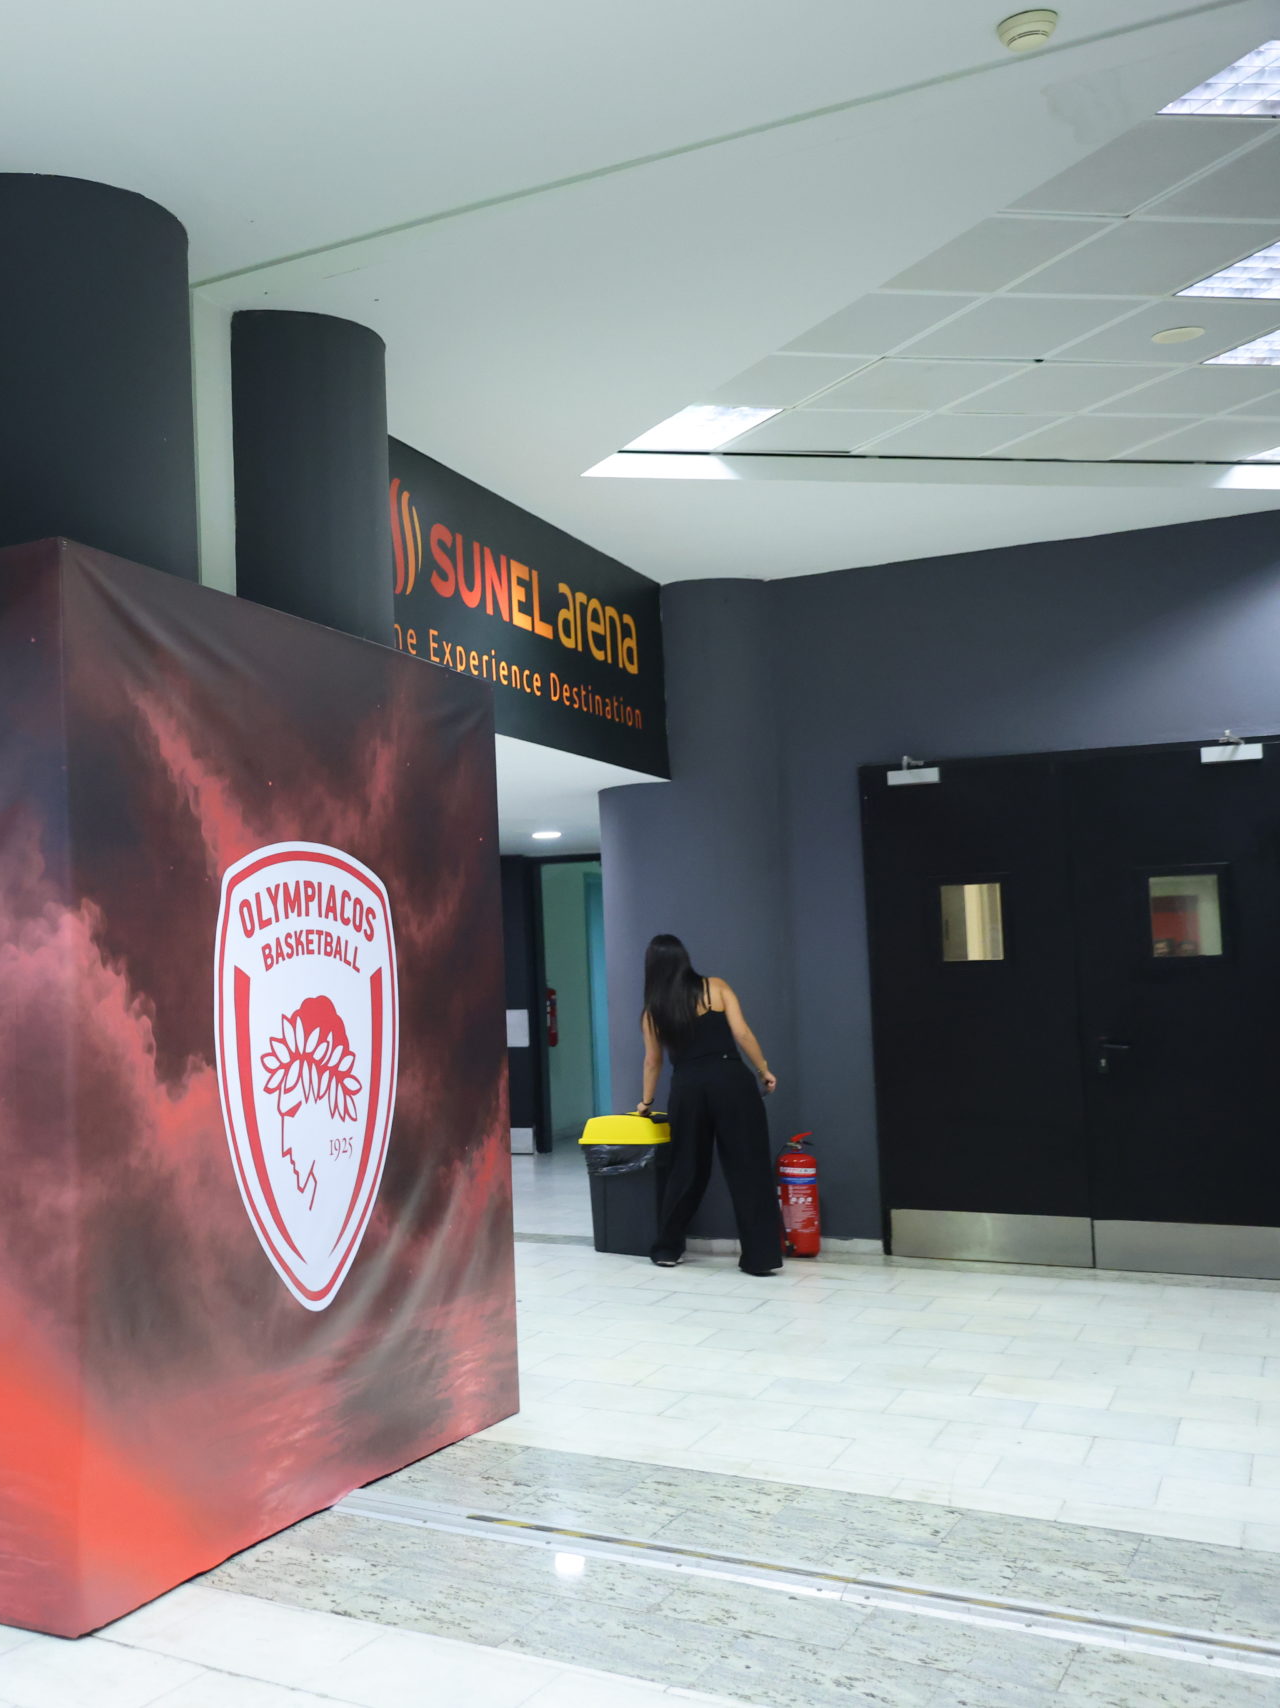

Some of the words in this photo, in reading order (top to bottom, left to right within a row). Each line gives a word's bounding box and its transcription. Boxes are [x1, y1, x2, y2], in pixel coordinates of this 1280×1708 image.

[429, 523, 554, 640] SUNEL
[557, 582, 639, 675] arena
[428, 628, 542, 697] Experience
[549, 672, 642, 729] Destination
[238, 879, 377, 943] OLYMPIACOS
[261, 928, 361, 974] BASKETBALL
[328, 1135, 354, 1159] 1925
